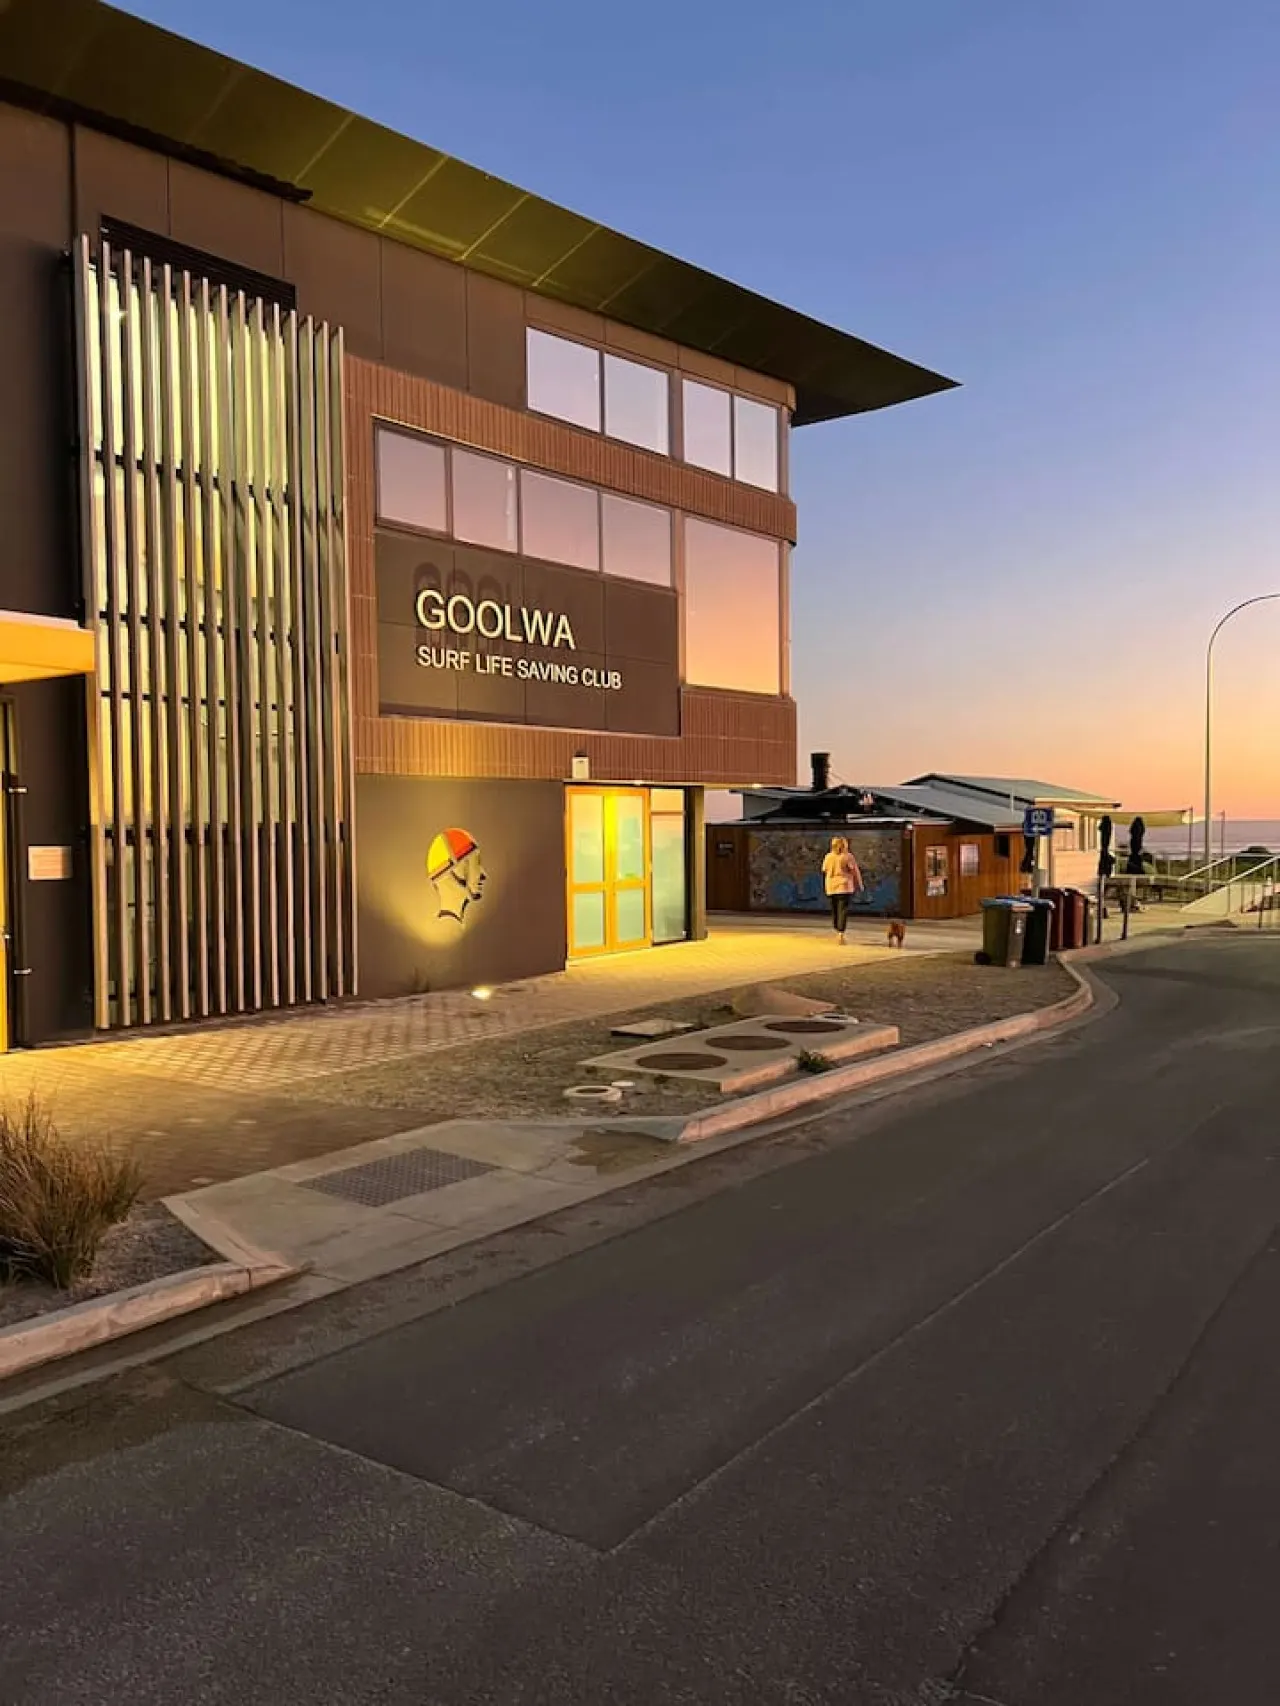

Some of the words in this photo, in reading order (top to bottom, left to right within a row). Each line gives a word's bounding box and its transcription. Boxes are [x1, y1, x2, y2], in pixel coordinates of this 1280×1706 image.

[416, 589, 576, 650] GOOLWA
[417, 645, 470, 670] SURF
[476, 653, 513, 676] LIFE
[517, 659, 578, 684] SAVING
[582, 667, 622, 690] CLUB
